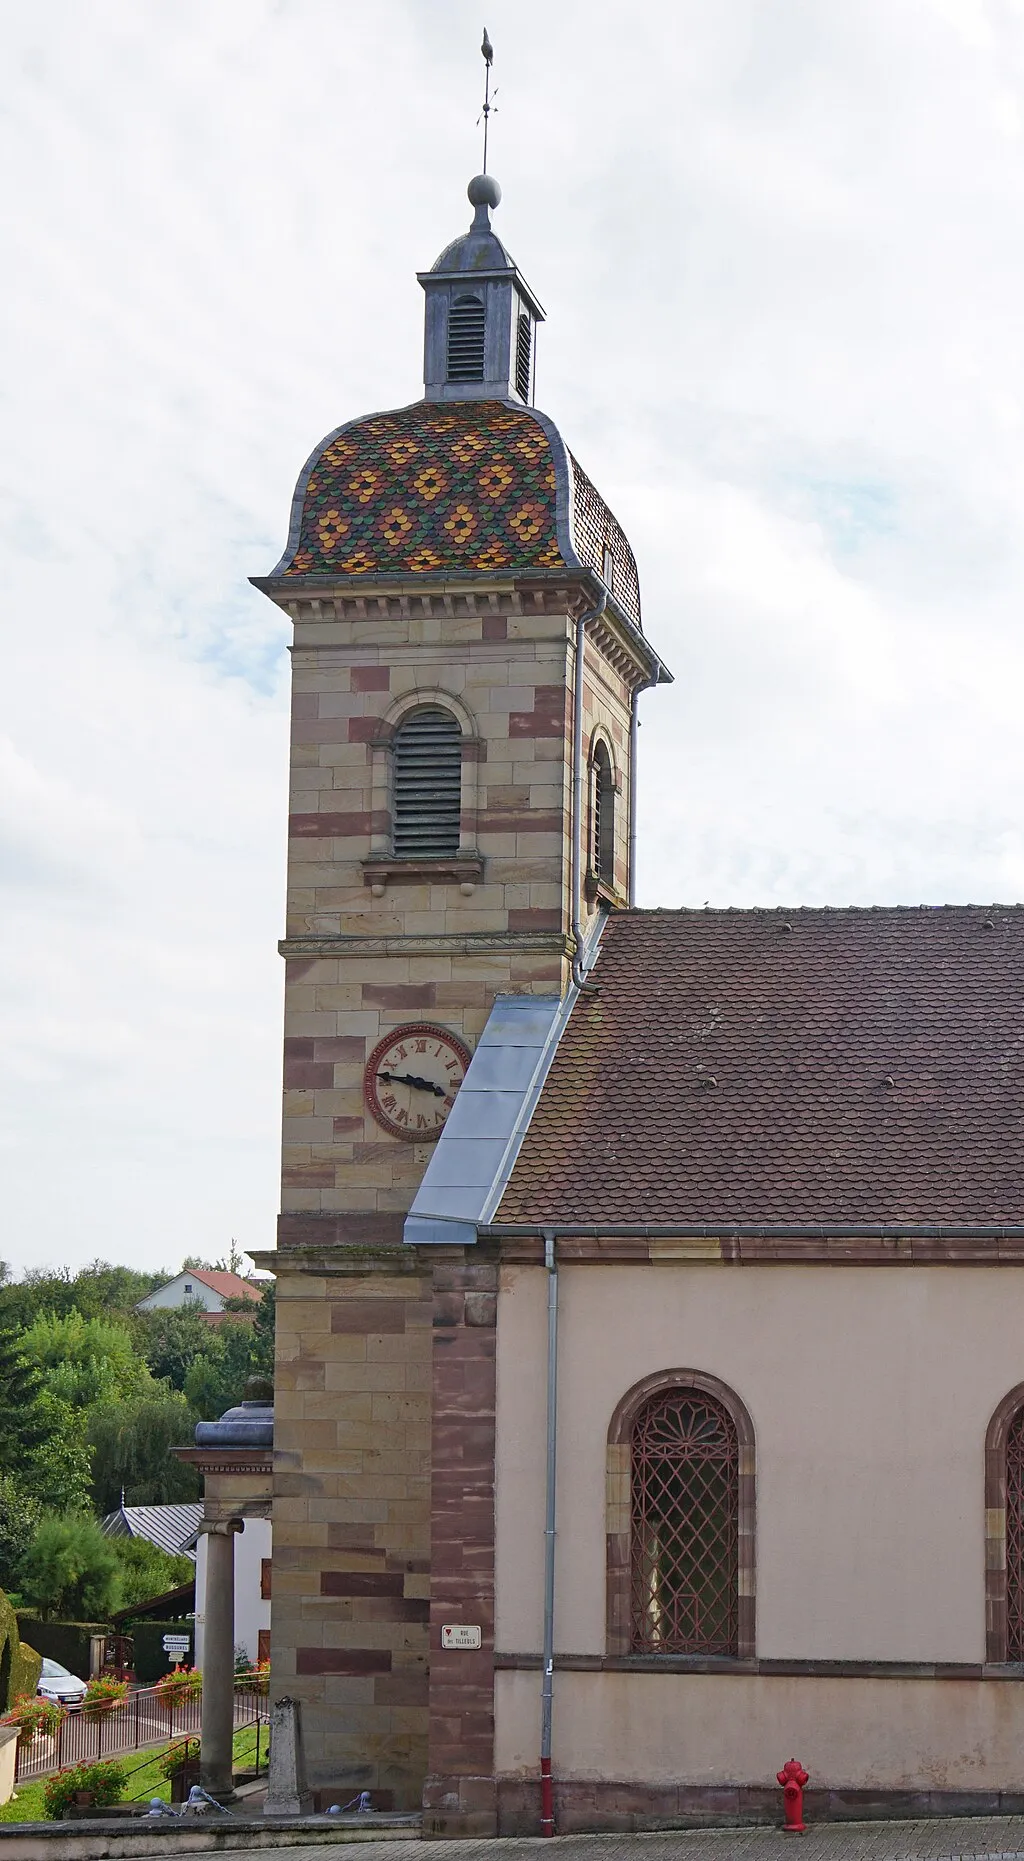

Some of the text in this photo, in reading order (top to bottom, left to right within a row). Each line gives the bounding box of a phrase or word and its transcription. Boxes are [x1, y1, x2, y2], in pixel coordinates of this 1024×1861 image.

[415, 1039, 428, 1053] XII
[434, 1044, 444, 1057] I
[383, 1059, 398, 1071] X
[445, 1060, 458, 1070] II
[416, 1114, 428, 1128] VI
[435, 1110, 446, 1124] V
